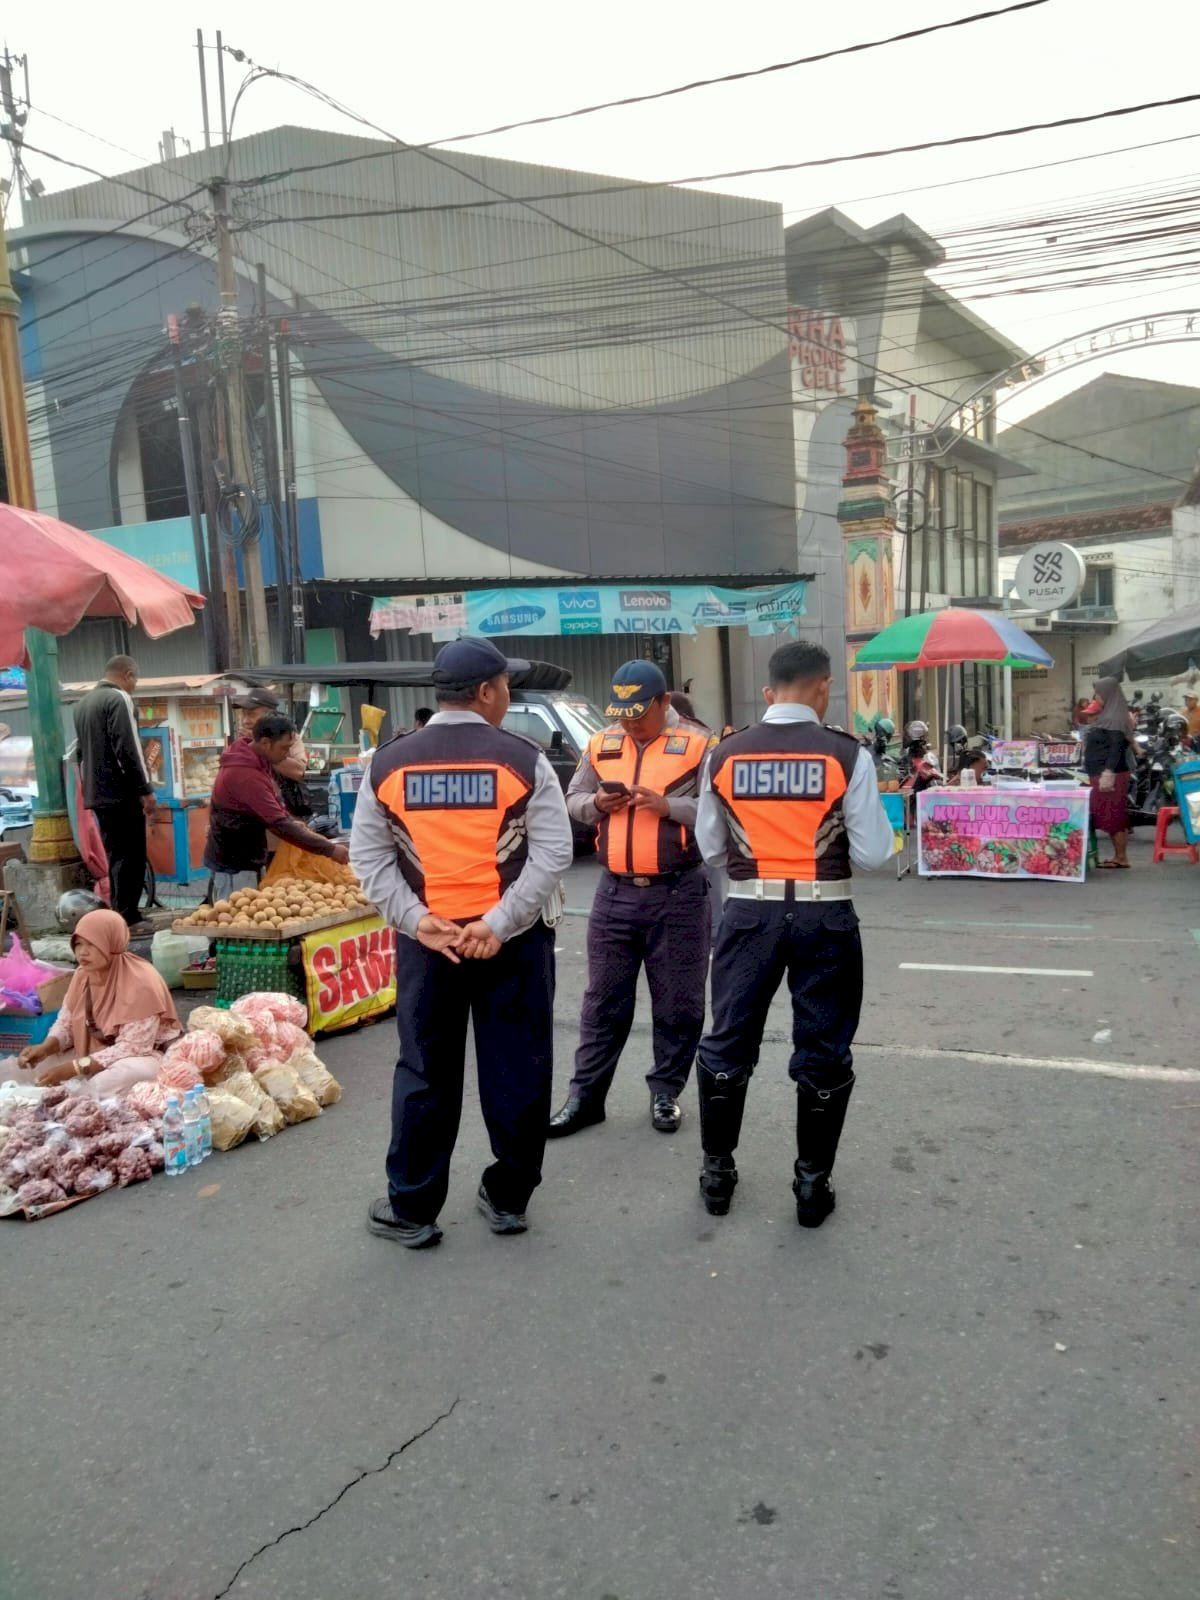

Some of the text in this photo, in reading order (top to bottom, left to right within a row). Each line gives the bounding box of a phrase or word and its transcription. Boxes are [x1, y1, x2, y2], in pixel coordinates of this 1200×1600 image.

[1028, 586, 1065, 596] PUSAT
[623, 594, 667, 607] Lenovo
[487, 612, 539, 626] SAMSUNG
[613, 617, 682, 632] NOKIA
[734, 761, 823, 794] DISHUB
[406, 774, 494, 803] DISHUB
[933, 804, 1070, 823] KUE LUK CHUP
[956, 821, 1045, 839] THAILAND
[312, 927, 398, 1014] SAW
